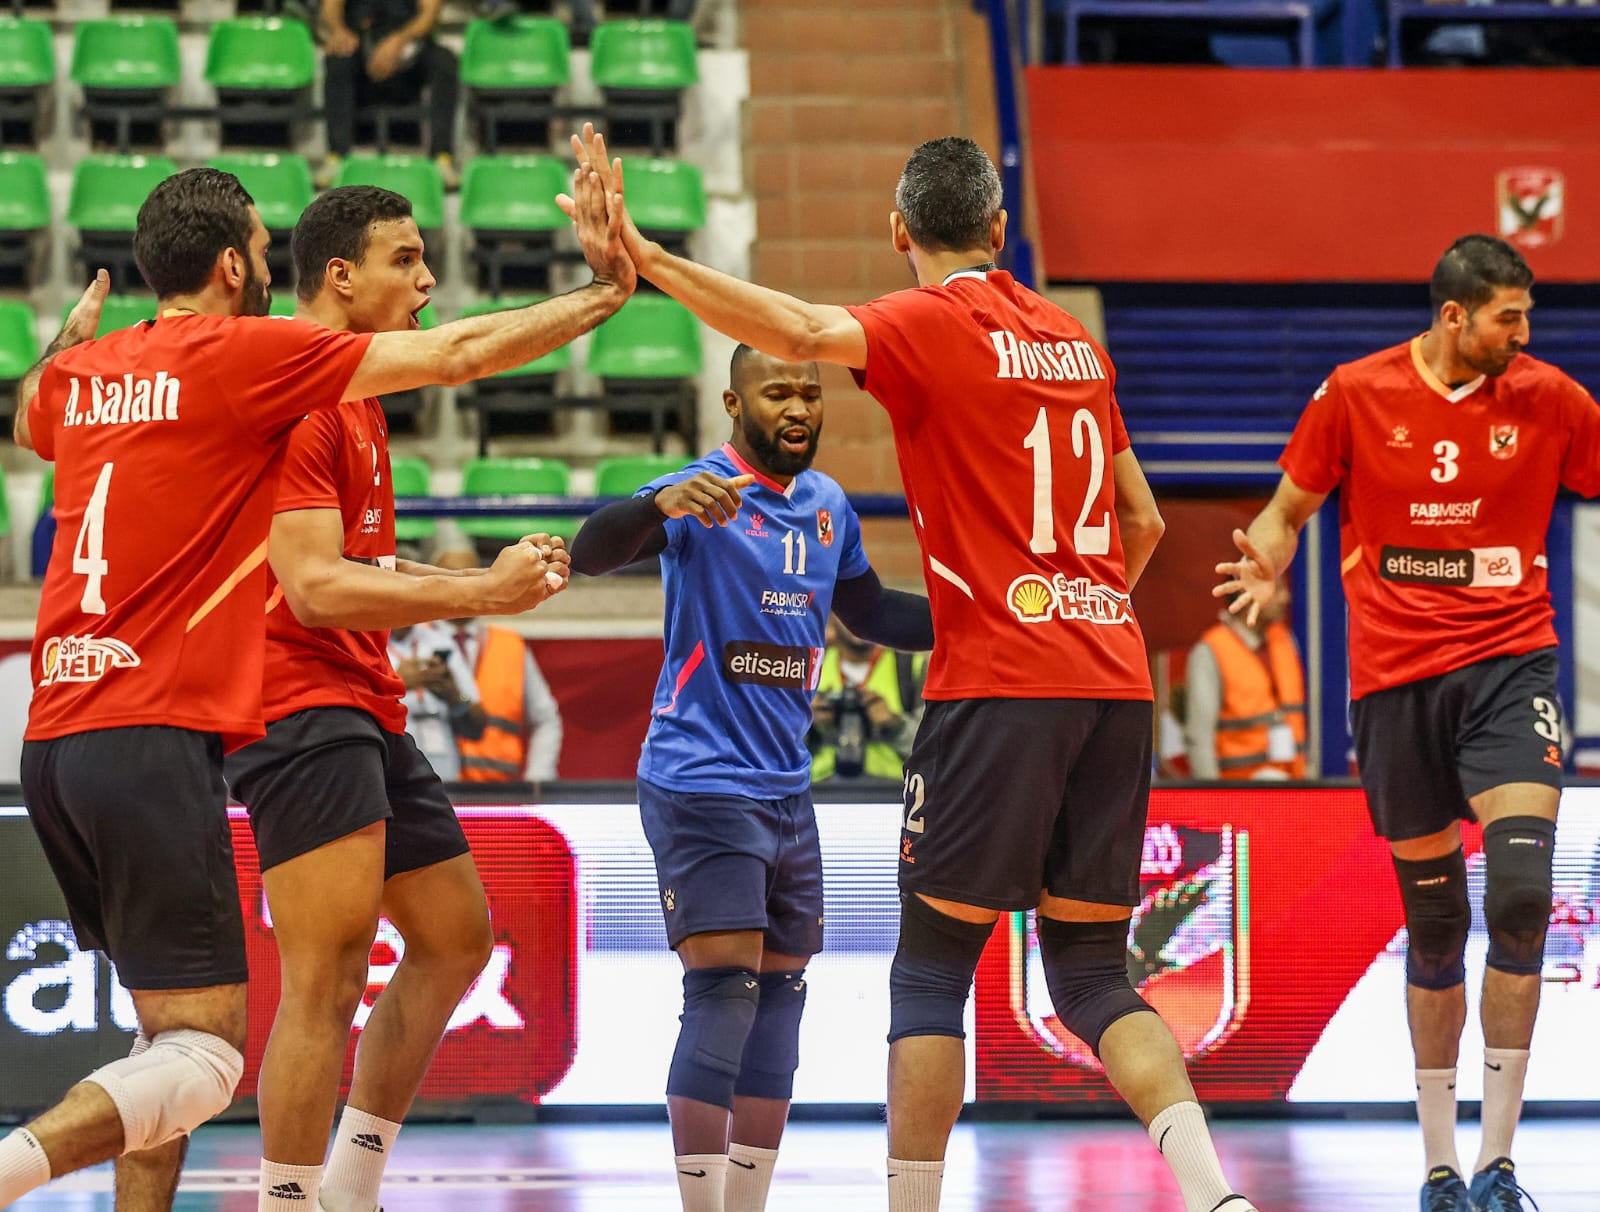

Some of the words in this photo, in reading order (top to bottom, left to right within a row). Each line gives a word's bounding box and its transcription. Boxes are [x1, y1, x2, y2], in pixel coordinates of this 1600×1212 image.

[989, 331, 1105, 381] Hossam
[1023, 406, 1110, 555] 12
[1430, 440, 1460, 483] 3
[72, 462, 114, 615] 4
[781, 530, 807, 575] 11
[1386, 555, 1467, 579] etisalat
[761, 590, 809, 608] FABMISR
[730, 652, 806, 680] etisalat
[1533, 697, 1560, 743] 3
[351, 1137, 384, 1154] adidas
[268, 1190, 307, 1201] adidas
